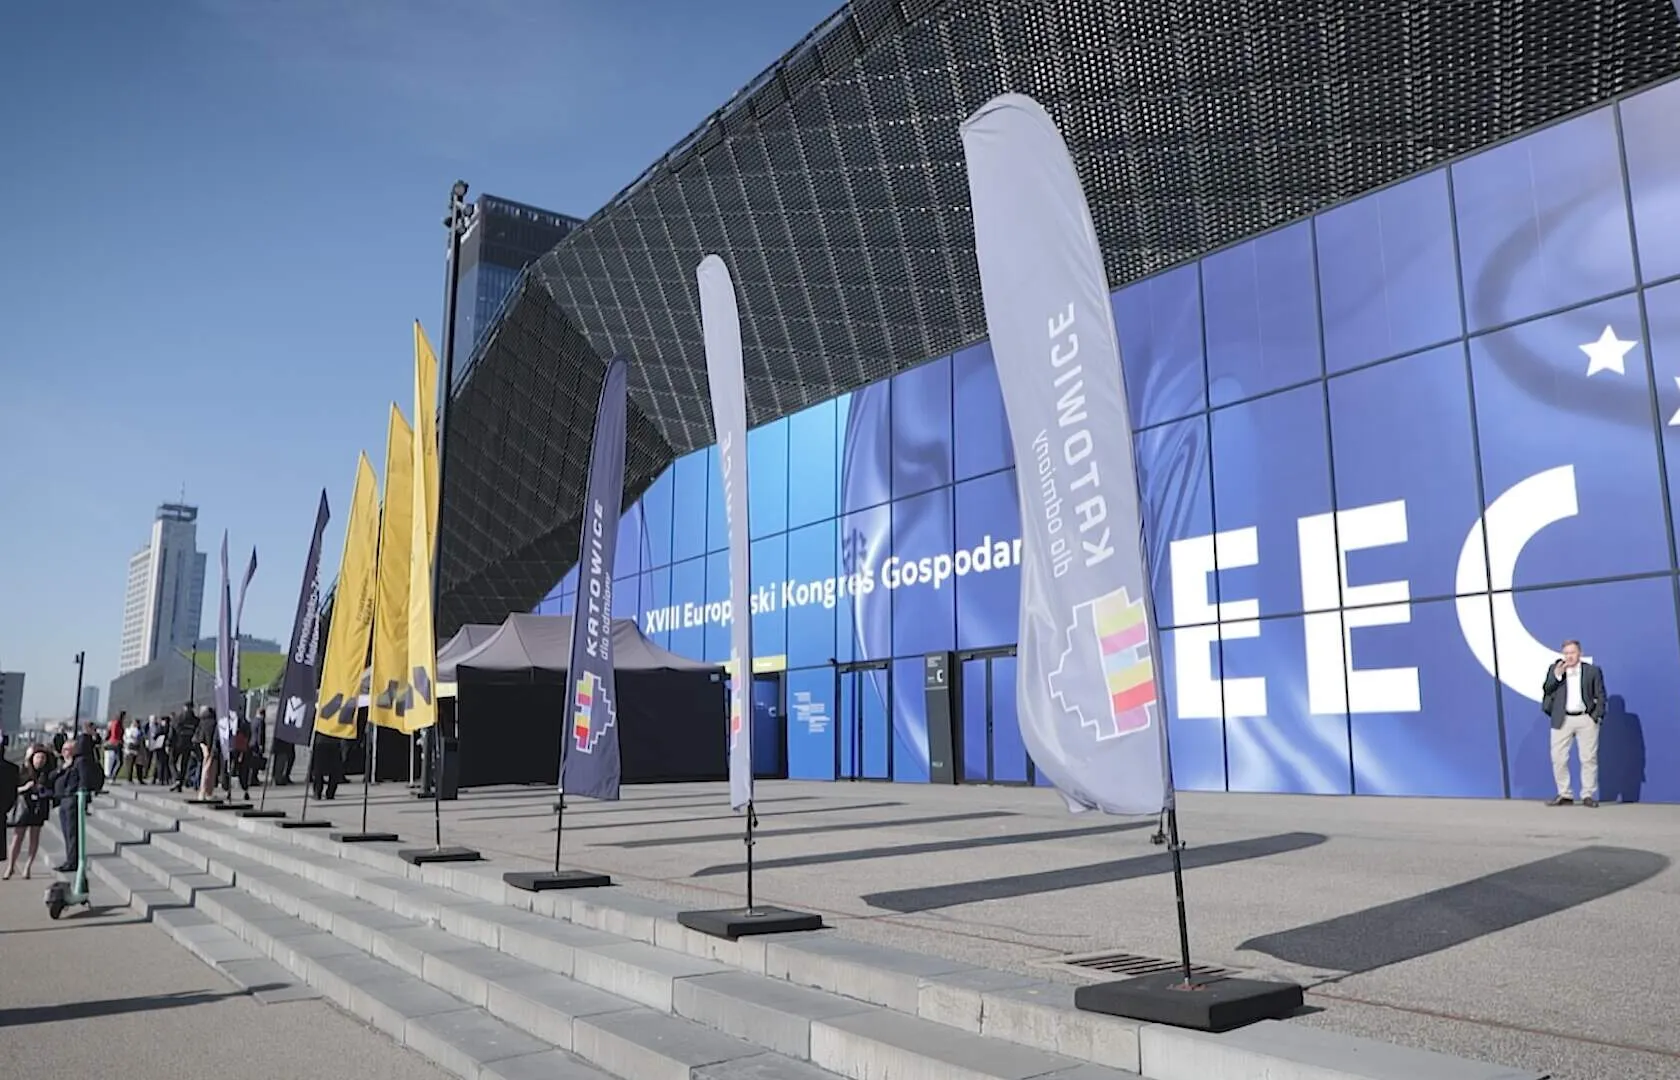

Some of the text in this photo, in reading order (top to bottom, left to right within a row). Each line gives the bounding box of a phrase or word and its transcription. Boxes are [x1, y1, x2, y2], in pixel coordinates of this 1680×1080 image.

[586, 499, 604, 657] KATOWICE
[646, 534, 1023, 634] XVIII Europski Kongres Gospodar
[1170, 464, 1593, 719] EEC
[600, 638, 610, 660] dla
[936, 668, 944, 683] C
